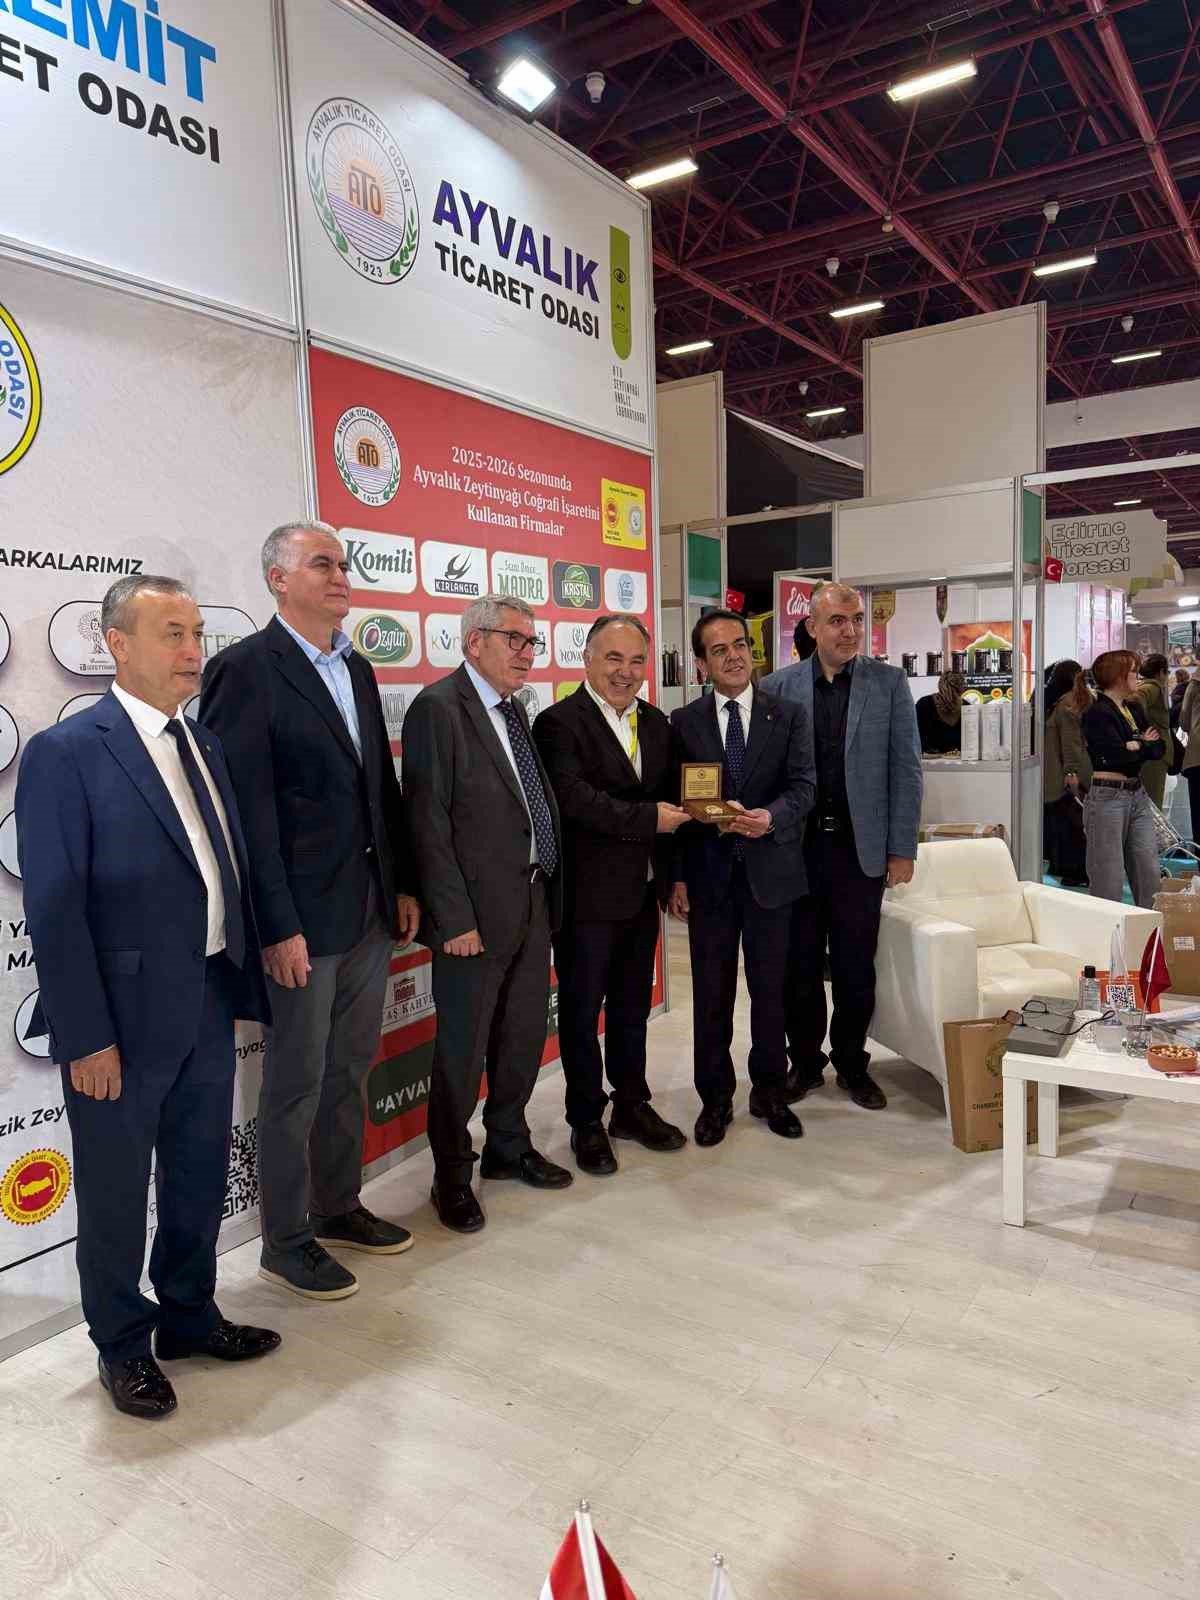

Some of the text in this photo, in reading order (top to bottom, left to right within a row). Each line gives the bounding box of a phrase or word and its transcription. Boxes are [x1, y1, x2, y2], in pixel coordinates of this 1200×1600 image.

[78, 72, 220, 164] ODASI
[312, 103, 412, 193] AYVALIK TİCARET ODASI
[349, 164, 382, 216] ATO
[432, 180, 600, 303] AYVALIK
[356, 257, 383, 278] 1923
[434, 241, 600, 339] TİCARET ODASI
[0, 340, 26, 420] ODASI
[358, 441, 380, 467] ATO
[452, 446, 572, 491] 2025-2026 Sezonunda
[413, 464, 600, 521] Ayvalık Zeytinyağı Coğrafi İşaretini
[467, 503, 565, 537] Kullanan Firmalar
[1051, 520, 1127, 542] Edirne
[344, 539, 414, 584] Komili
[1052, 536, 1130, 560] Ticaret
[1062, 557, 1130, 577] orsası
[498, 573, 544, 601] MADRA
[363, 618, 406, 652] Özgün
